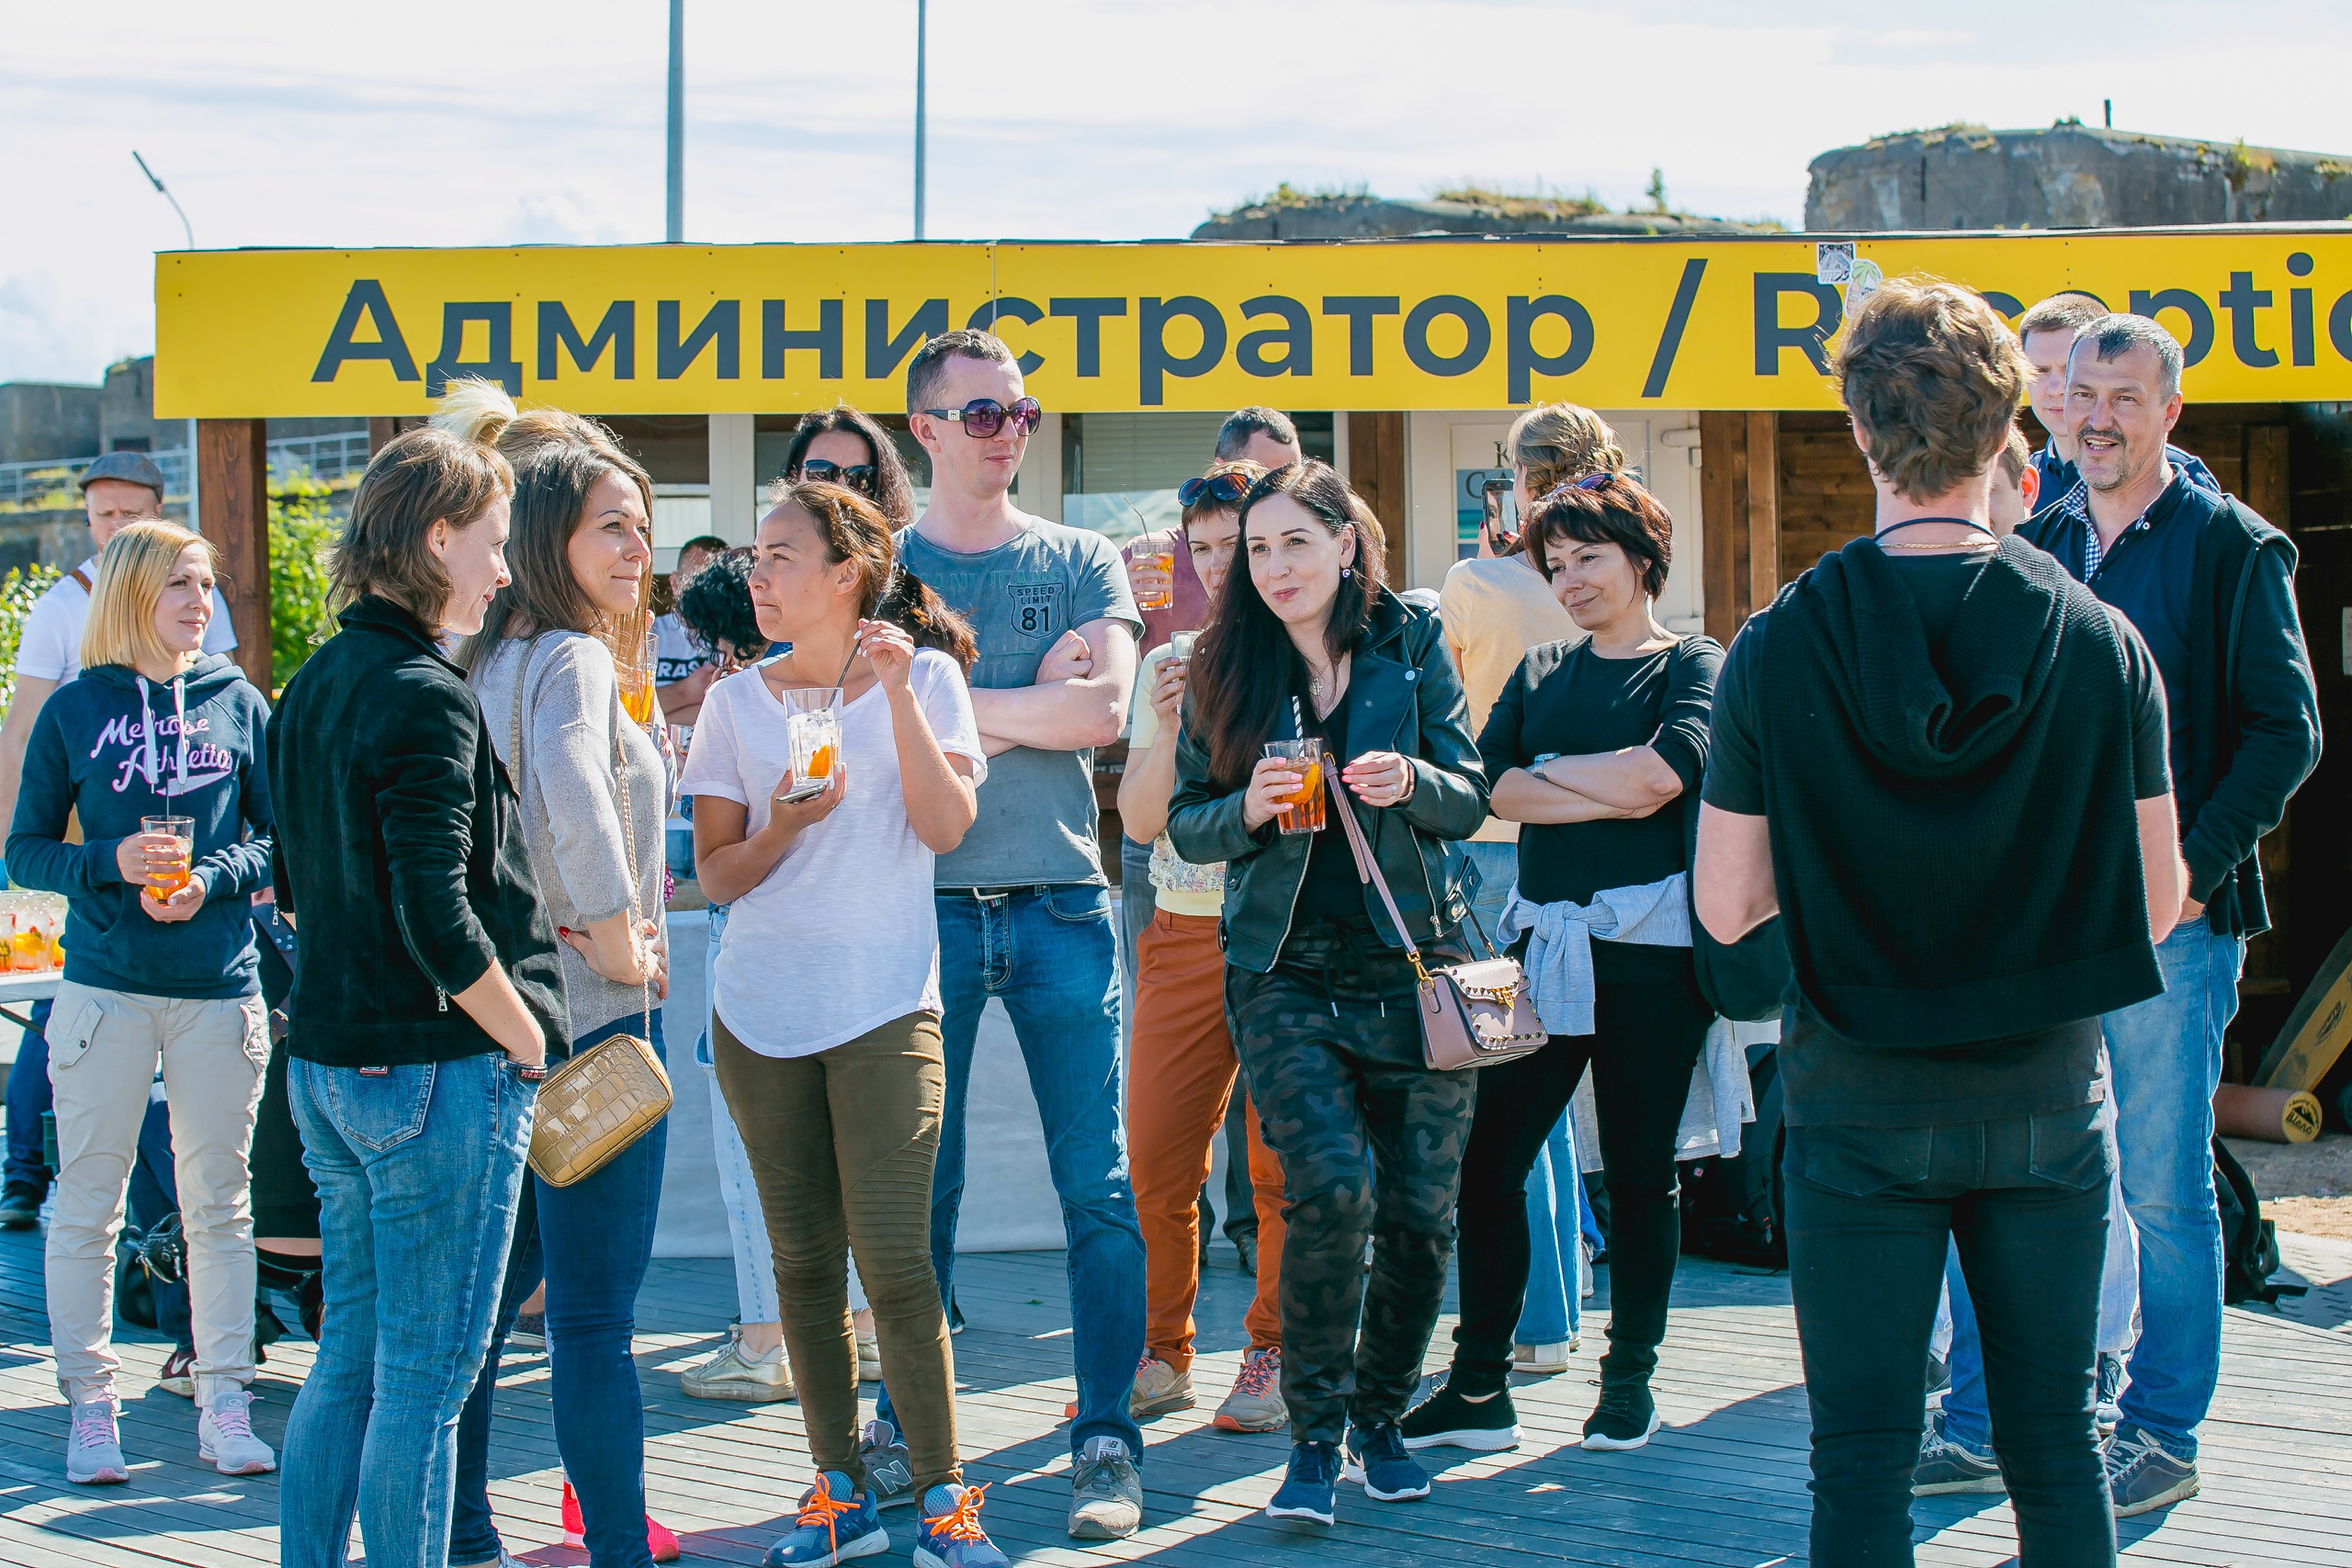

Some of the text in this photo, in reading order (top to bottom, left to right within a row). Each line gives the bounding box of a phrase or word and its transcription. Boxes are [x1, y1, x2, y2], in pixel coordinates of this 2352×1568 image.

[311, 258, 1708, 406] Администратор /
[1753, 252, 2352, 376] Rpti
[1017, 586, 1055, 596] SPEED
[1021, 595, 1051, 605] LIMIT
[1021, 606, 1049, 632] 81
[90, 709, 210, 759] Merose
